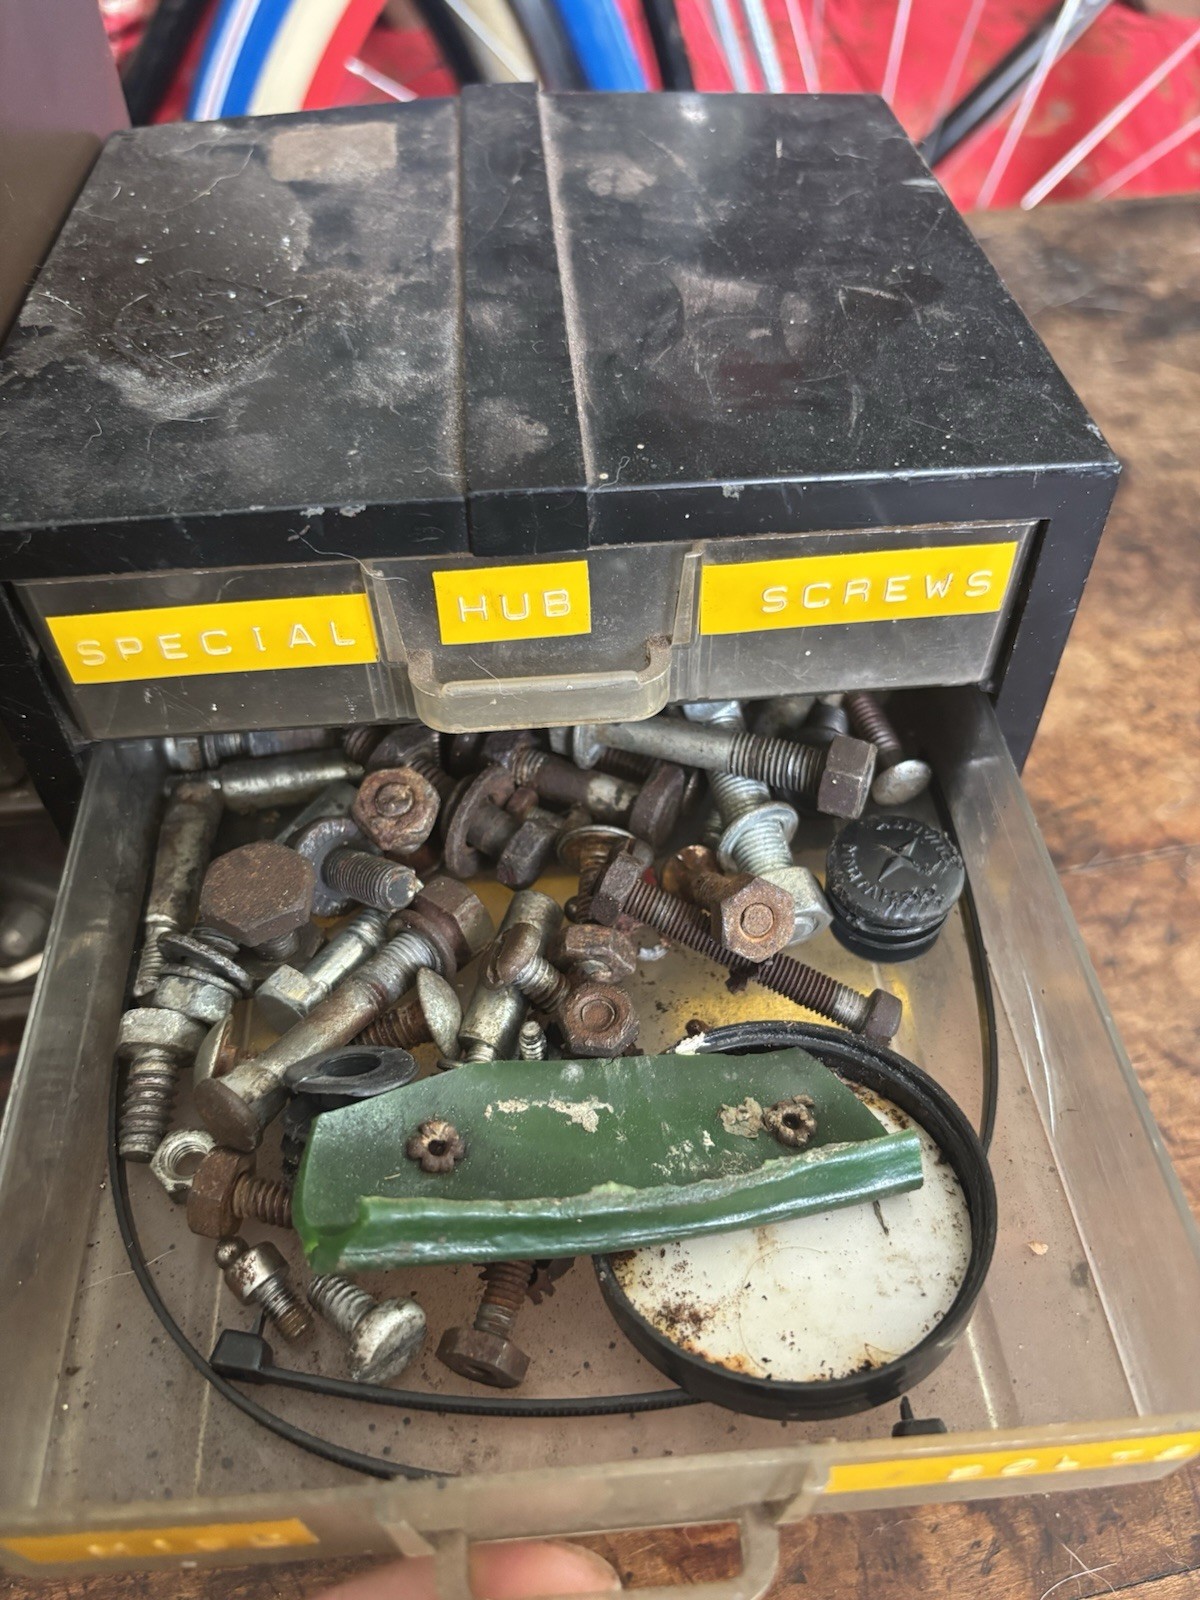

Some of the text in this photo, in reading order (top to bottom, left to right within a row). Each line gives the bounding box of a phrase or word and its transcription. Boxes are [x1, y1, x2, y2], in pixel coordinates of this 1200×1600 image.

[77, 569, 993, 666] SPECIAL HUB SCREWS
